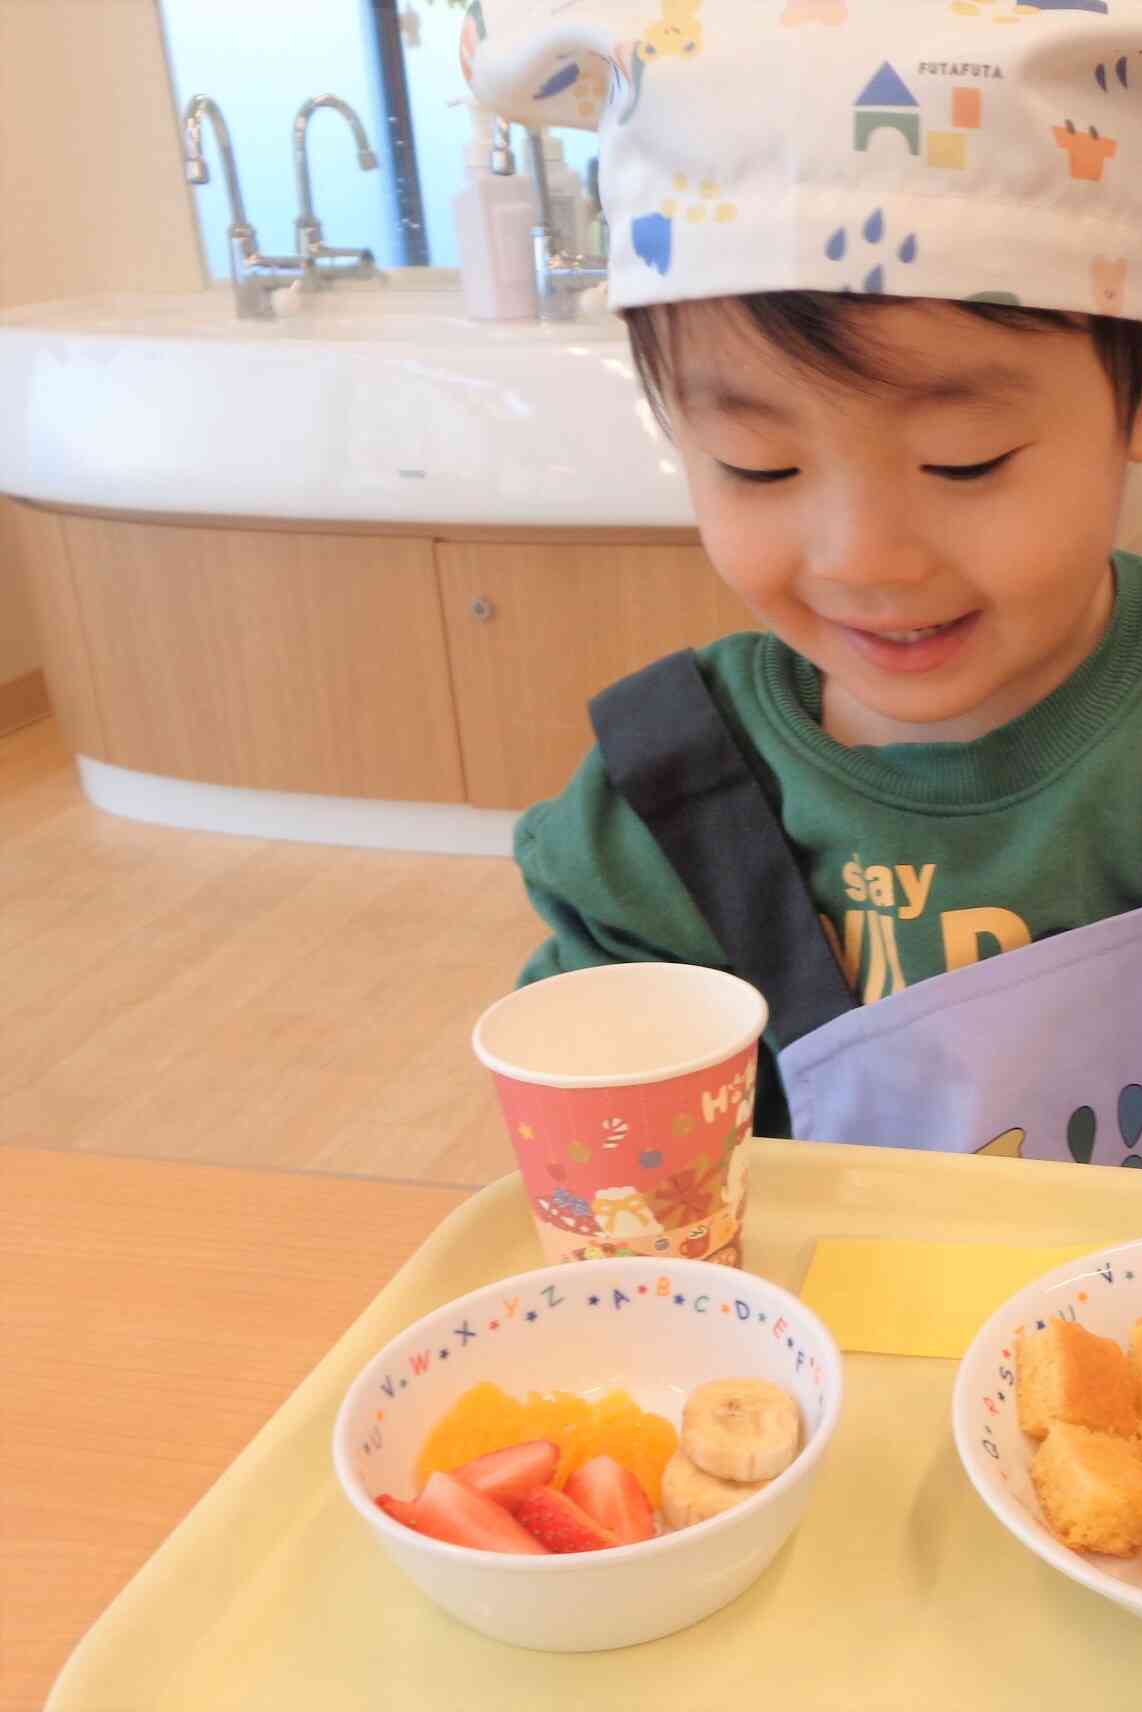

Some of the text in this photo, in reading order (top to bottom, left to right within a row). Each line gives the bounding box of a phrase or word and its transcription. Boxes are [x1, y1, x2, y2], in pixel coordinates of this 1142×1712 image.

[917, 61, 1004, 79] FUTAFUTA
[842, 856, 937, 920] say
[380, 1374, 396, 1398] V
[409, 1349, 432, 1377] W
[453, 1319, 477, 1346] X
[503, 1296, 520, 1319] Y
[540, 1285, 566, 1308] Z
[612, 1288, 631, 1311] A
[656, 1275, 672, 1297] B
[694, 1295, 711, 1313] C
[735, 1300, 750, 1321] D
[773, 1316, 788, 1339] E
